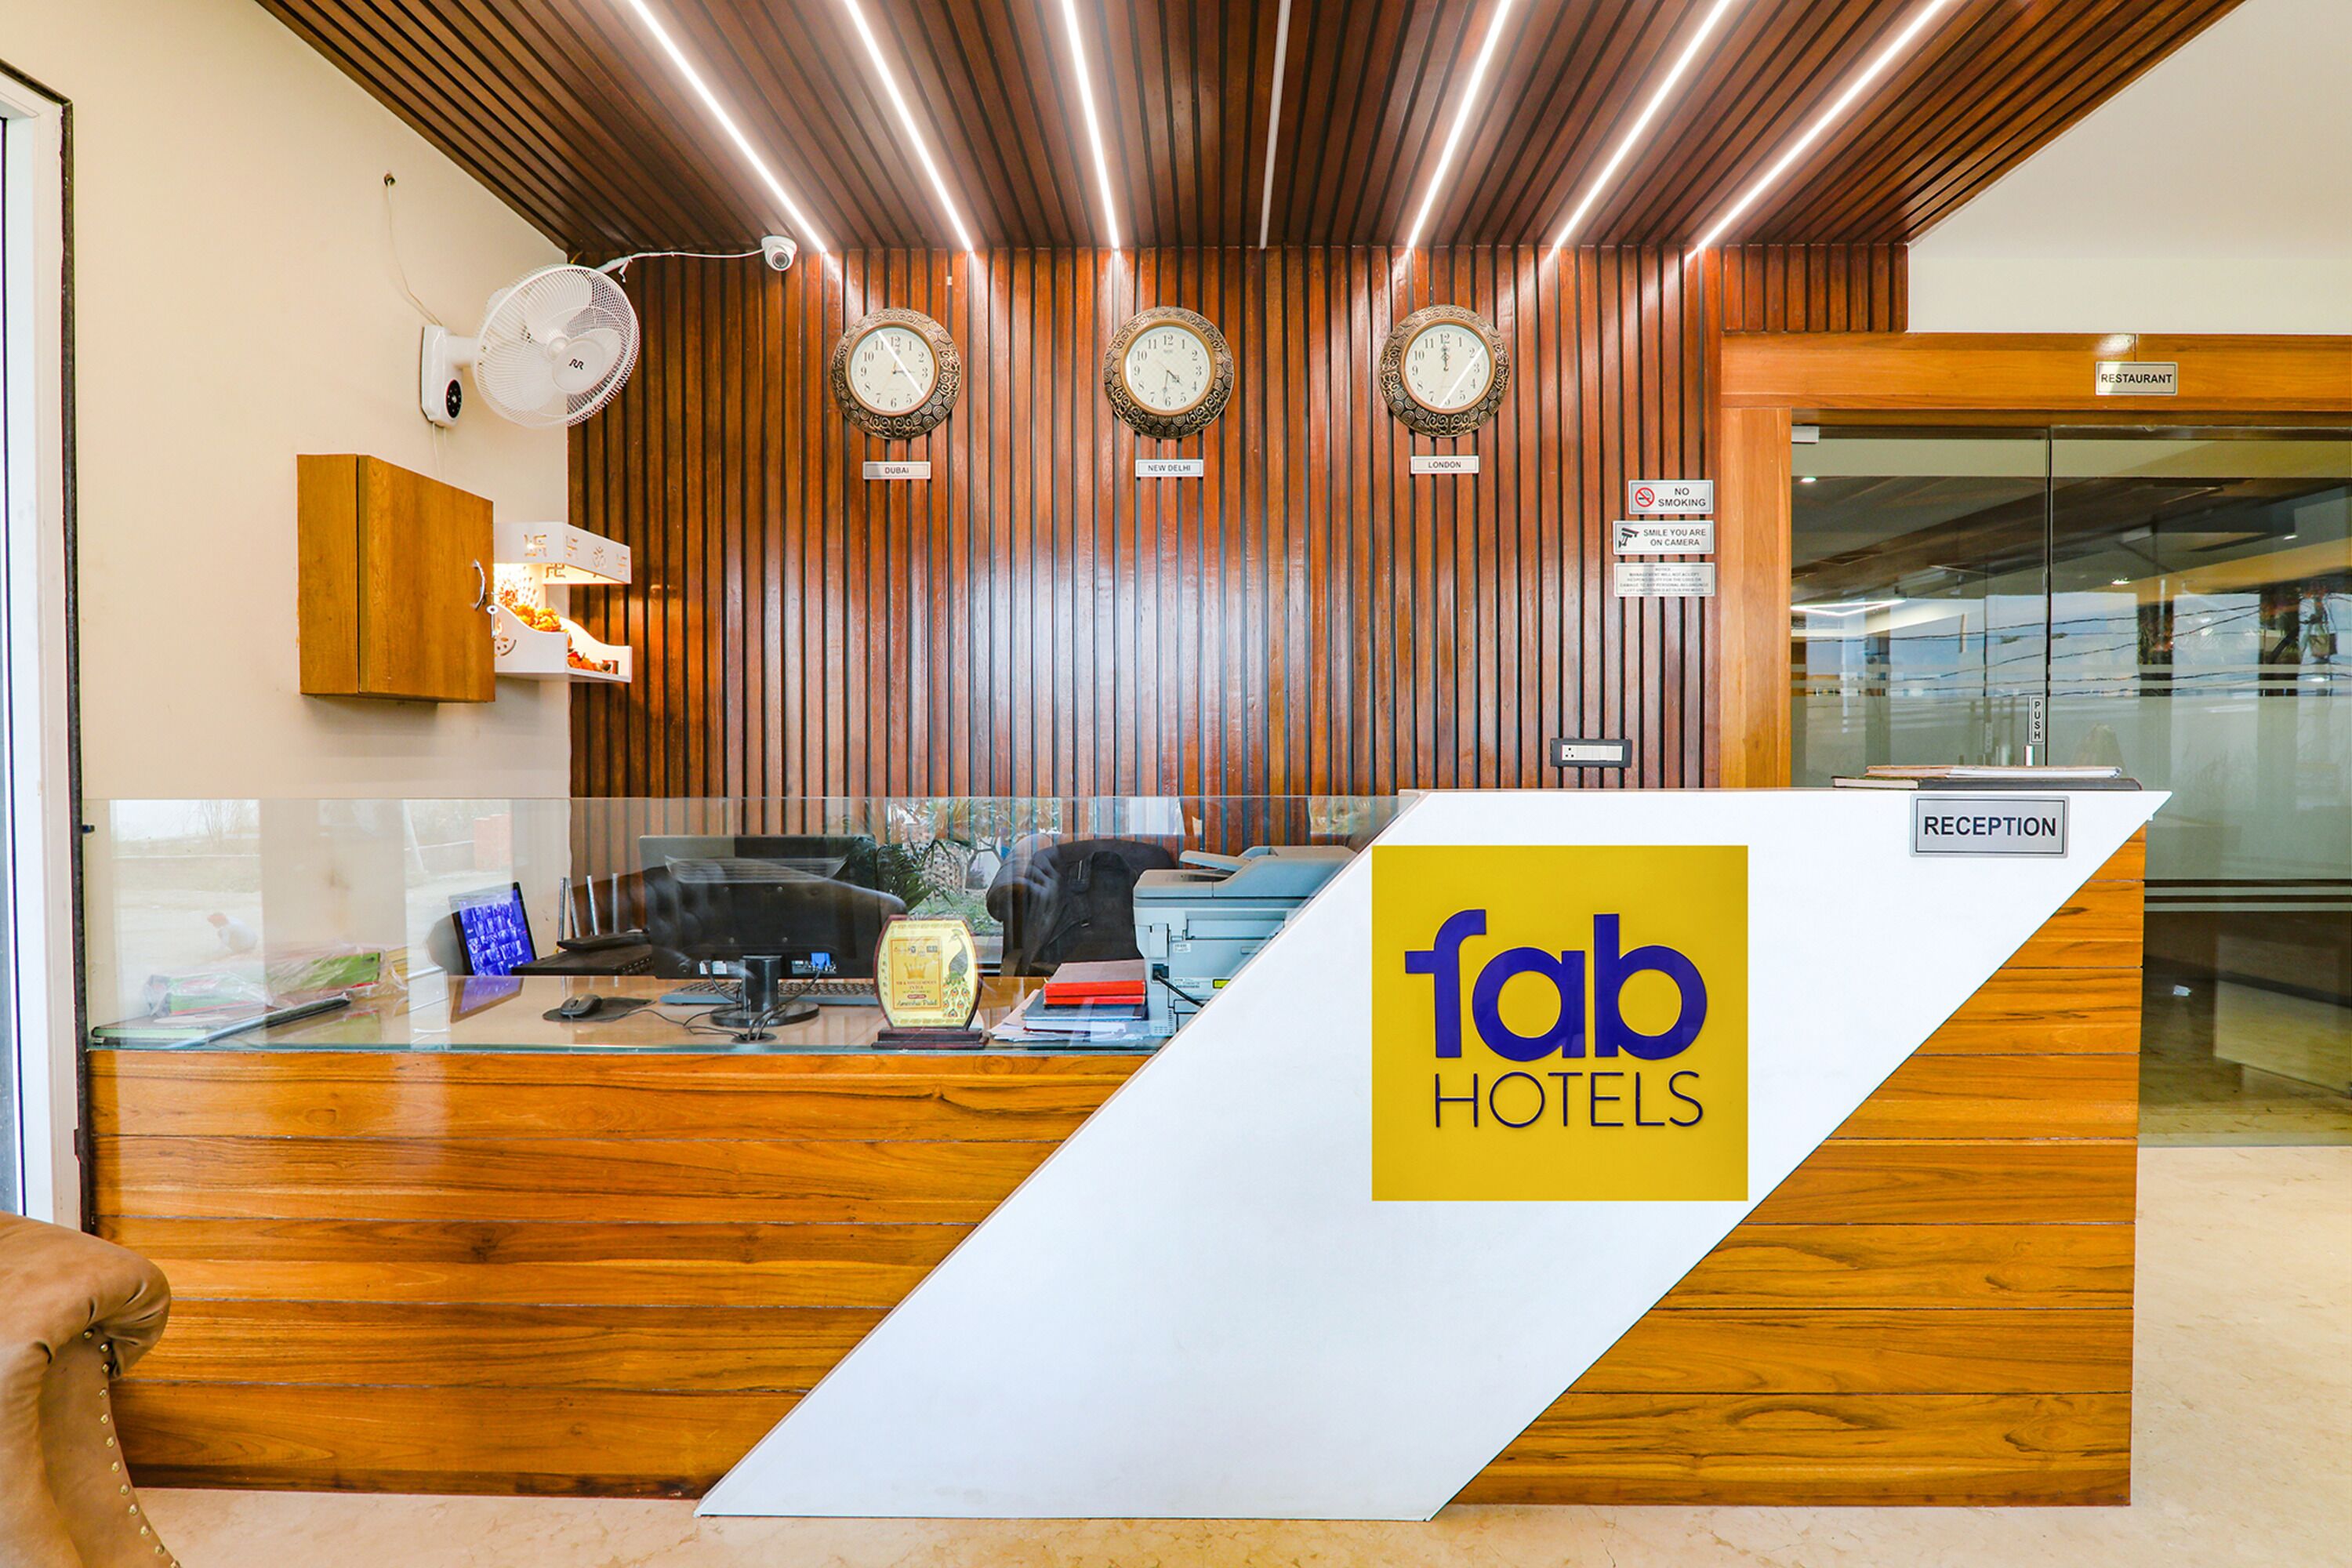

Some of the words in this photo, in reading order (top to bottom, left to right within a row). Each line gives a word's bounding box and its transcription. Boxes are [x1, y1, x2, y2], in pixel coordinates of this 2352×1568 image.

[891, 336, 900, 347] 12
[1163, 335, 1173, 345] 12
[1440, 333, 1450, 343] 12
[875, 340, 884, 350] 11
[1148, 339, 1156, 349] 11
[1425, 339, 1433, 348] 11
[864, 351, 874, 361] 10
[918, 352, 924, 362] 2
[1137, 350, 1147, 361] 10
[1192, 350, 1198, 361] 2
[1414, 350, 1425, 361] 10
[1469, 347, 1475, 358] 2
[860, 366, 866, 376] 9
[922, 367, 928, 377] 3
[1134, 365, 1140, 376] 9
[1196, 365, 1202, 376] 3
[1412, 365, 1418, 376] 9
[1474, 363, 1480, 373] 3
[2101, 373, 2172, 383] RESTAURANT
[864, 382, 870, 391] 8
[1138, 381, 1145, 390] 8
[1192, 381, 1197, 391] 4
[1417, 380, 1423, 391] 8
[1470, 379, 1475, 389] 4
[876, 393, 881, 404] 7
[906, 394, 912, 404] 5
[1149, 392, 1155, 402] 7
[1180, 392, 1186, 402] 5
[1428, 391, 1434, 401] 7
[1459, 390, 1465, 400] 5
[891, 397, 897, 408] 6
[1165, 397, 1171, 407] 6
[1658, 498, 1706, 506] SMOKING
[1924, 816, 2056, 837] RECEPTION
[1405, 909, 1708, 1062] fab
[1435, 1071, 1704, 1128] HOTELS
